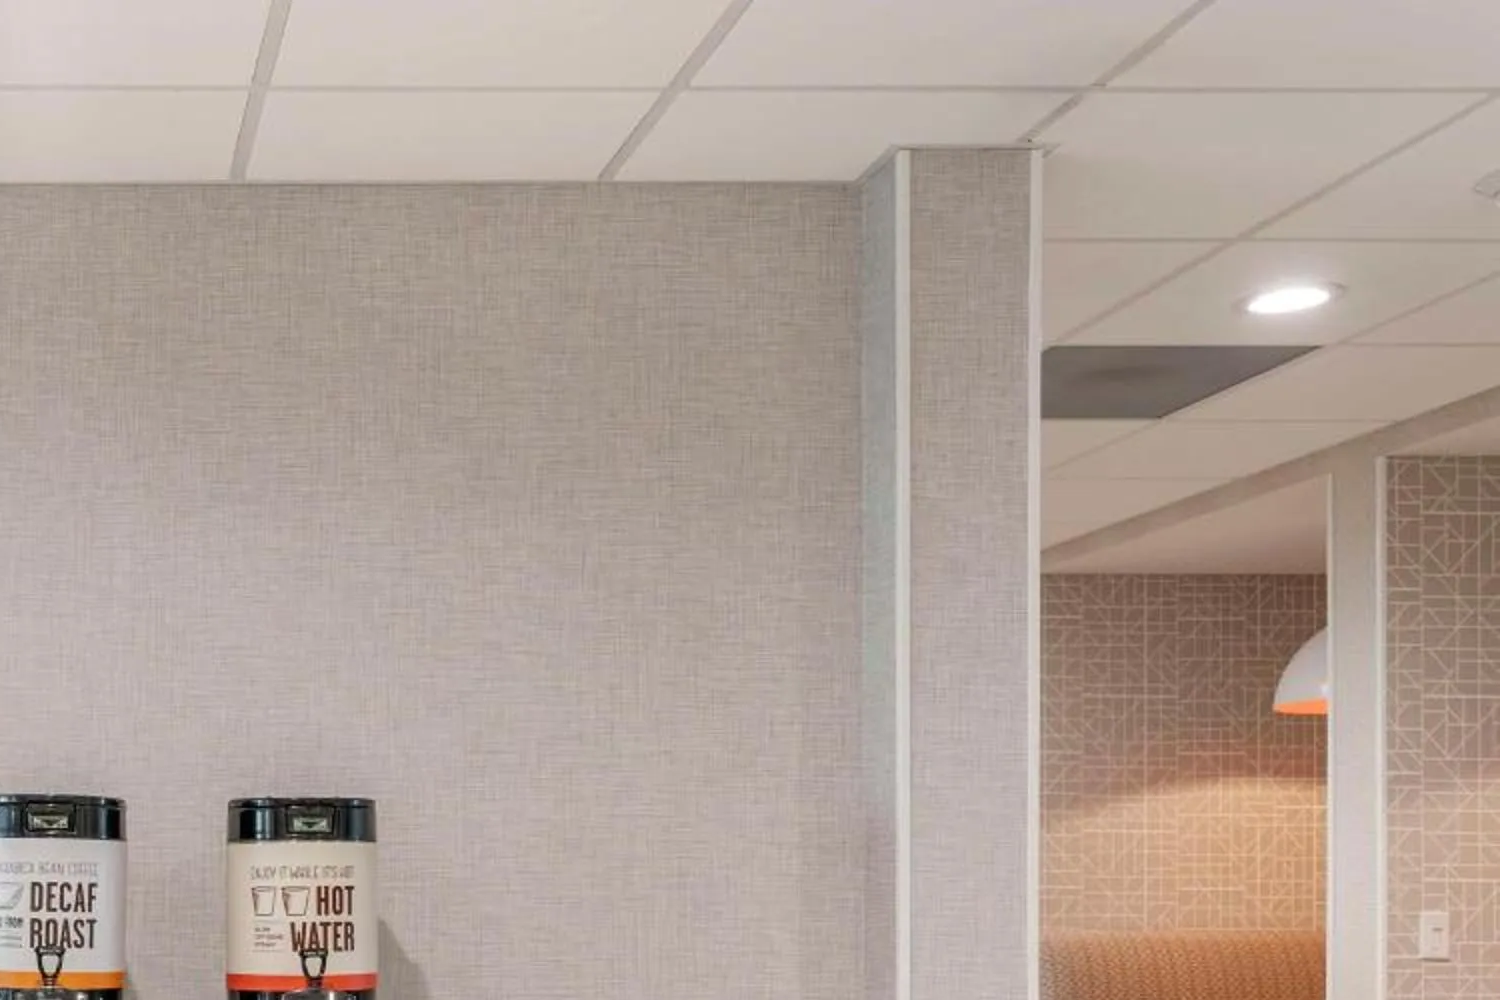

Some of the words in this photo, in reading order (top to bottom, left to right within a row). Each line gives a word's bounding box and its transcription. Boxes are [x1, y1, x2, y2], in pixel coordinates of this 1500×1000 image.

[29, 881, 98, 913] DECAF
[316, 885, 355, 916] HOT
[29, 917, 98, 949] ROAST
[290, 921, 355, 952] WATER
